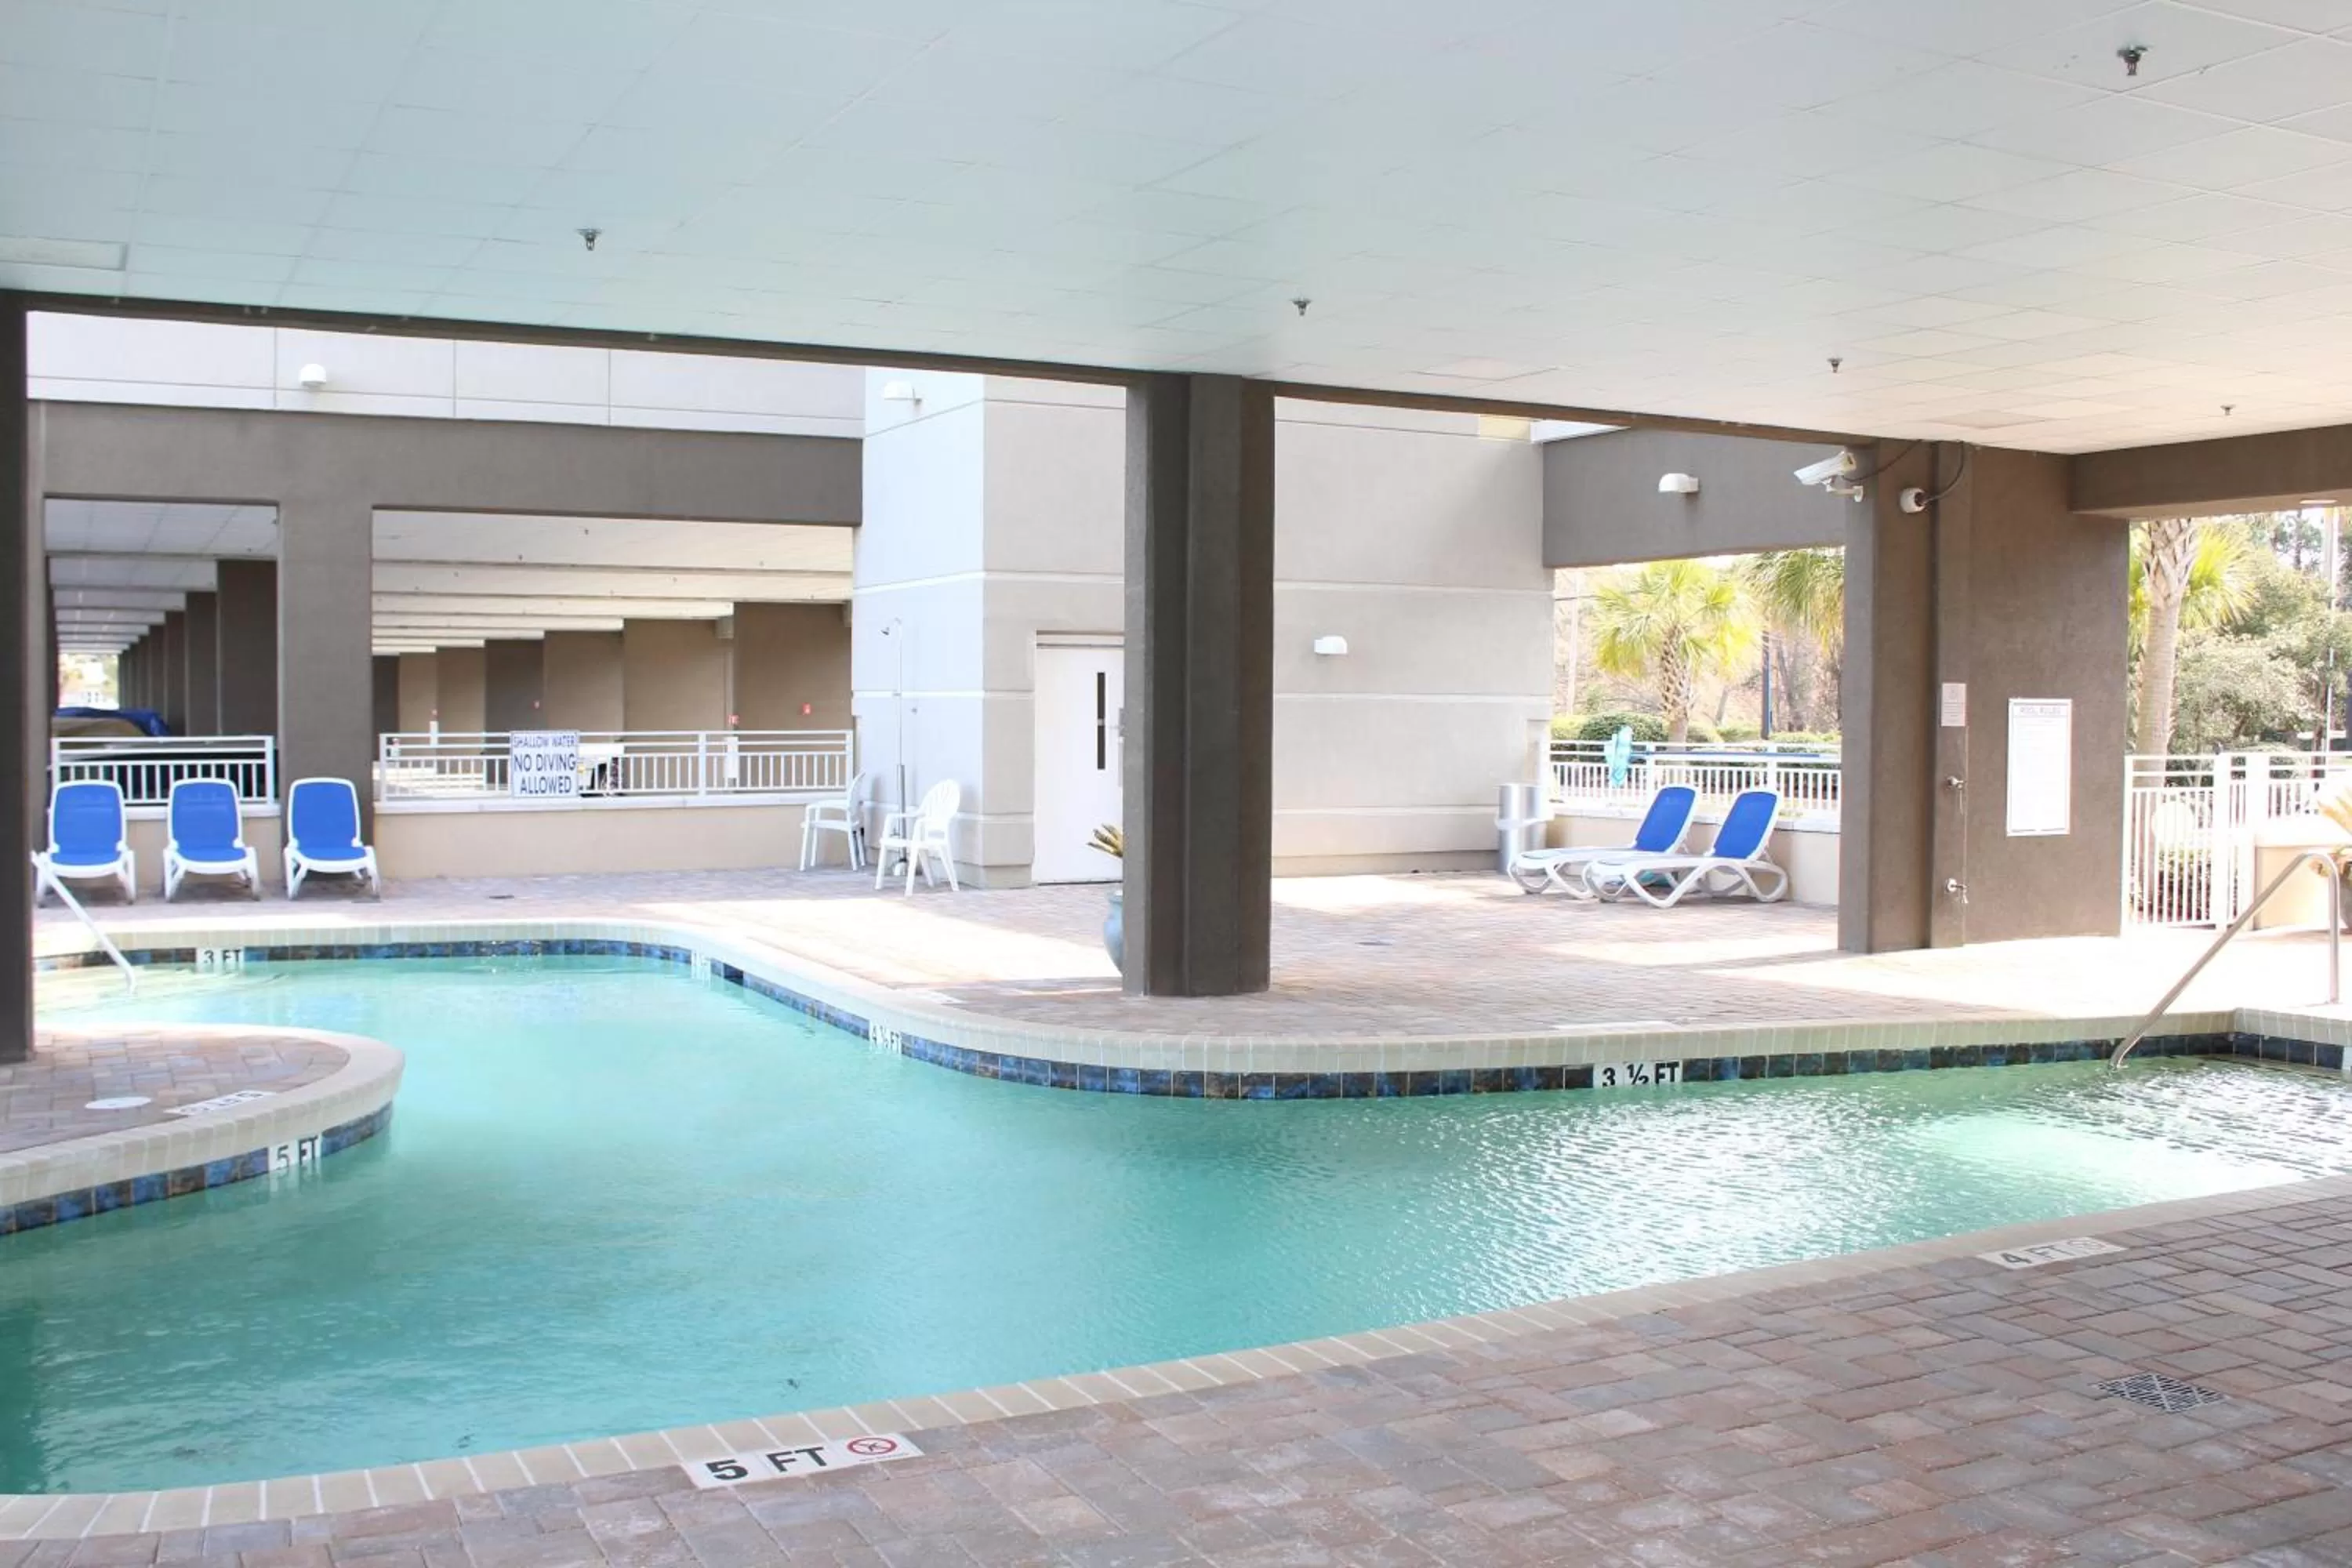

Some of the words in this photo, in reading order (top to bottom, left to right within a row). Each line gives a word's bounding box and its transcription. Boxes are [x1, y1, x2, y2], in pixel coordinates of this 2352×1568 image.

[514, 735, 549, 748] SHALLOW
[552, 735, 575, 747] WATER
[514, 753, 532, 771] NO
[535, 753, 576, 771] DIVING
[520, 775, 572, 793] ALLOWED
[204, 949, 214, 964] 3
[223, 949, 241, 963] FT
[1602, 1067, 1616, 1087] 3
[1655, 1061, 1679, 1084] FT
[277, 1145, 289, 1171] 5
[299, 1134, 318, 1166] FT
[1999, 1252, 2032, 1264] 4
[2024, 1245, 2078, 1260] FT
[706, 1459, 749, 1480] 5
[766, 1446, 827, 1472] FT
